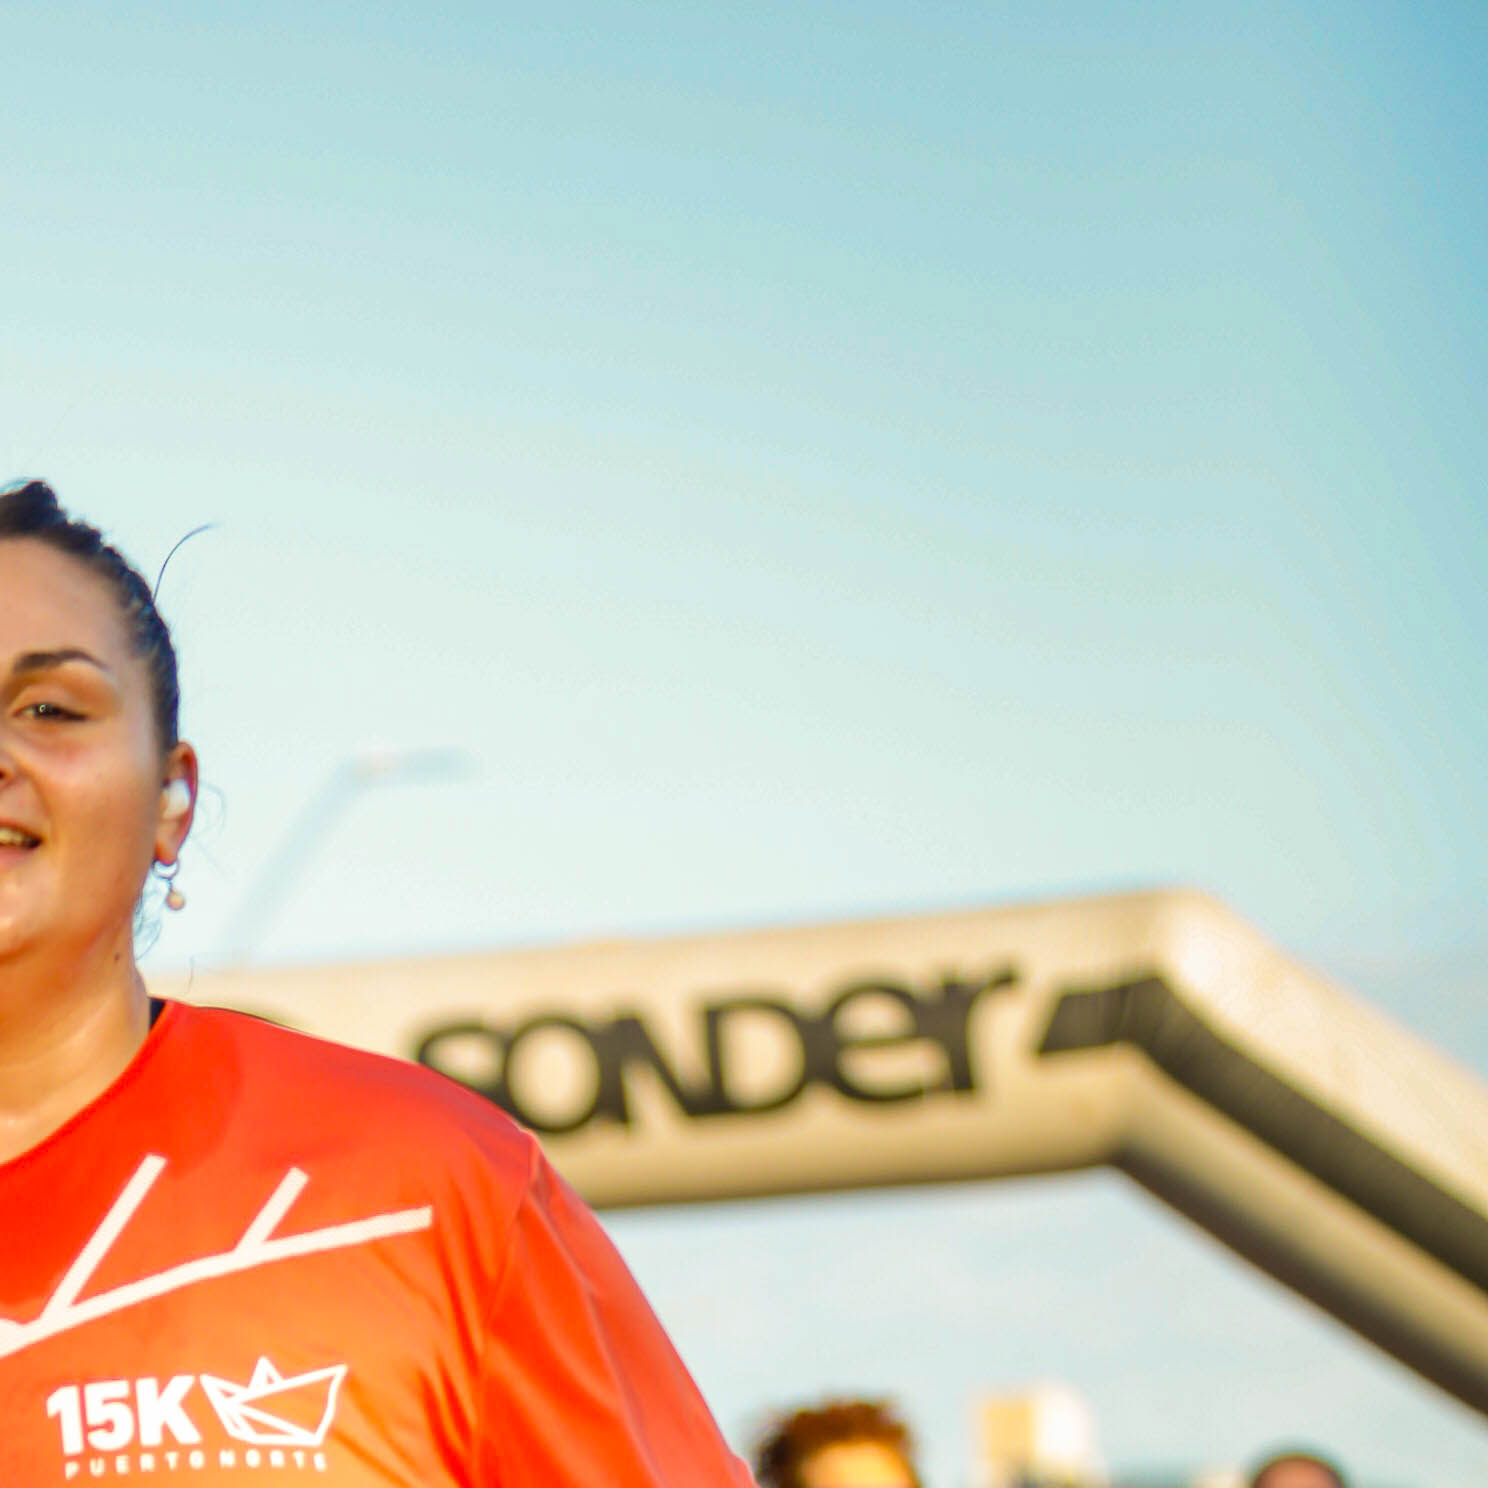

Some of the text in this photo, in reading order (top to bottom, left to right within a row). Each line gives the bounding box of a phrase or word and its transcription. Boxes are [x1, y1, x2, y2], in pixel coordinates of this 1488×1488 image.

[46, 1375, 203, 1455] 15K
[64, 1448, 328, 1480] PUERTO NORTE
